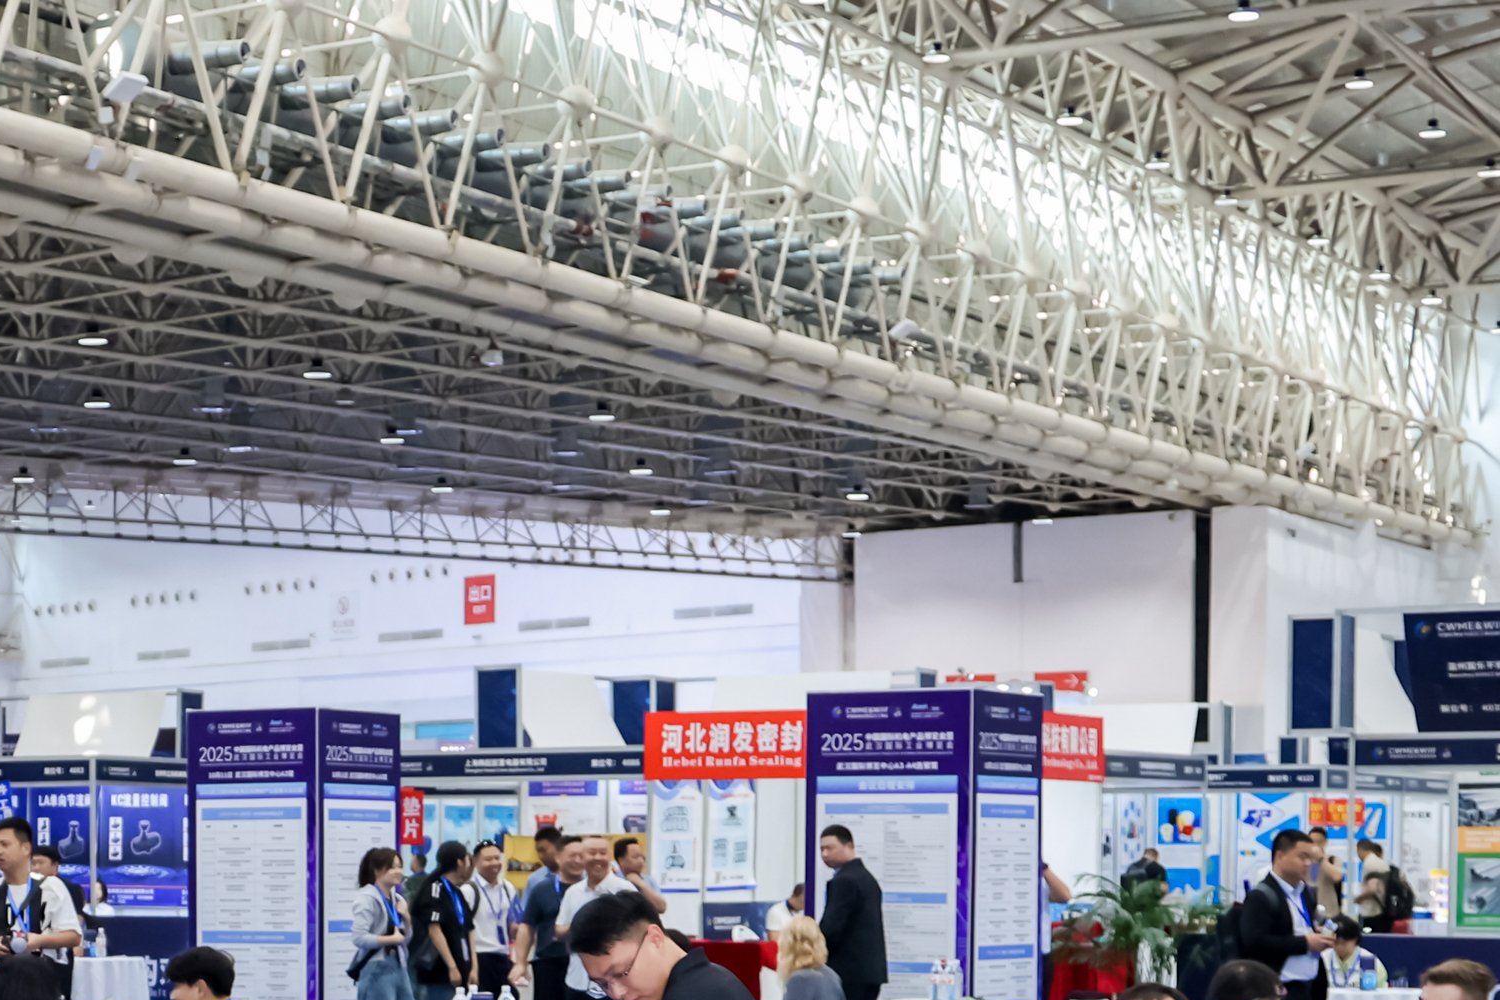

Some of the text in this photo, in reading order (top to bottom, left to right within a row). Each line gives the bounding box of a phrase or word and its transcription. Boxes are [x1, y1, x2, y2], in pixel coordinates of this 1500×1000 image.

[468, 584, 492, 603] 出口
[661, 720, 803, 754] 河北润发密封
[821, 733, 865, 751] 2025
[199, 746, 233, 762] 2025
[663, 755, 803, 767] Hebei Runfa Sealing
[110, 793, 168, 808] KC流量控制阀
[402, 796, 421, 840] 垫片
